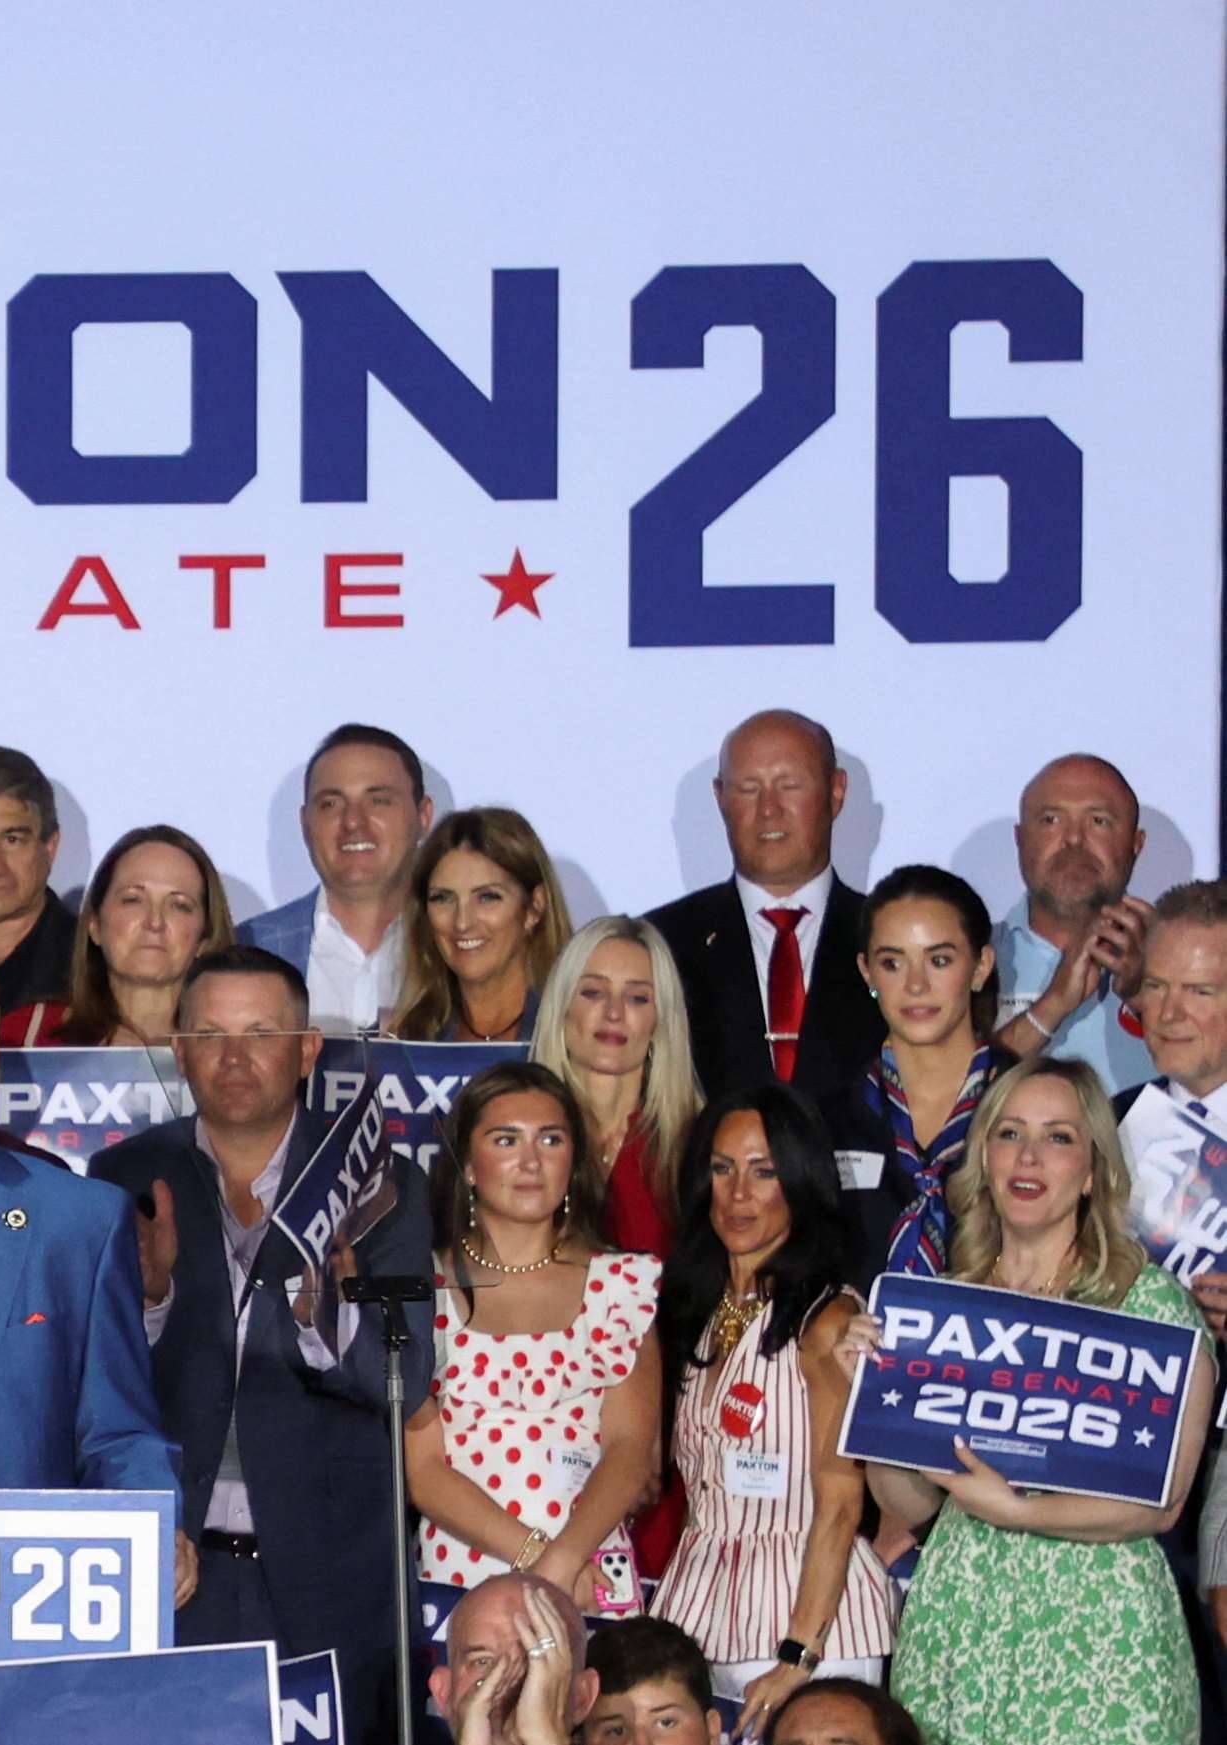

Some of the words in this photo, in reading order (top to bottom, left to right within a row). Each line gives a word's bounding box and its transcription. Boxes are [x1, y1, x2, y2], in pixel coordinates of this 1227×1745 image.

[629, 259, 1083, 647] 26
[302, 1088, 385, 1265] PAXTO
[877, 1356, 966, 1381] FOR
[990, 1369, 1173, 1416] SENATE
[881, 1306, 1182, 1396] PAXTON
[913, 1383, 1122, 1449] 2026
[736, 1460, 779, 1473] PAXTON
[11, 1546, 122, 1643] 26
